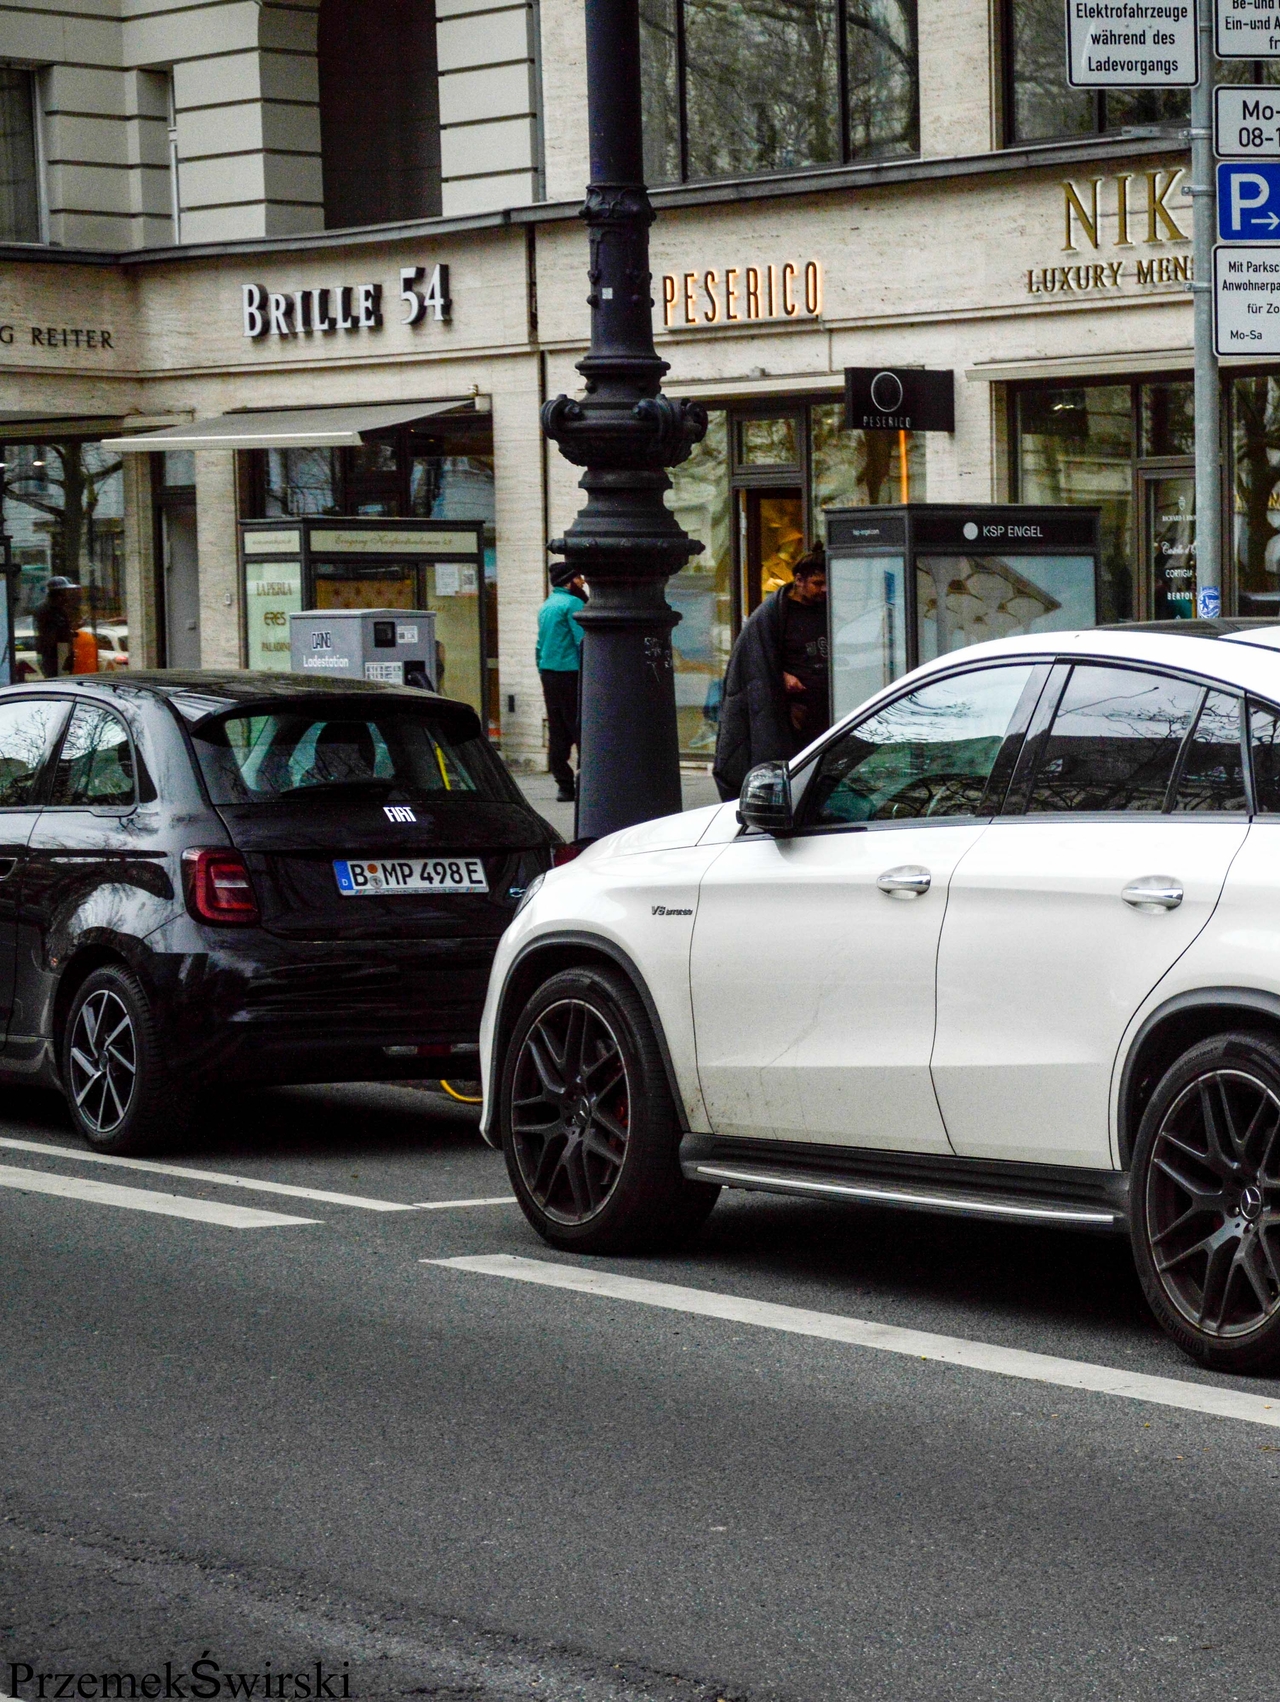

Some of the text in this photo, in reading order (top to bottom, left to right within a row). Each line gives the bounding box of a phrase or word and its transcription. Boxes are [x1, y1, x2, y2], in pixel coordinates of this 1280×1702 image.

[1076, 3, 1188, 22] Elektrofahrzeuge
[1090, 30, 1176, 45] während des
[1088, 56, 1179, 75] Ladevorgangs
[1230, 173, 1270, 231] P
[1026, 256, 1195, 294] LUXURY MEN
[1228, 261, 1245, 273] Mit
[400, 263, 452, 326] 54
[662, 260, 820, 326] PESERICO
[1247, 302, 1263, 315] für
[31, 327, 114, 349] REITER
[1230, 329, 1263, 341] Mo-Sa
[863, 416, 912, 428] PESERICO
[983, 525, 1044, 538] KSP ENGEL
[264, 611, 286, 626] ERES
[302, 654, 349, 667] Ladestation
[382, 806, 417, 823] FIAT
[350, 863, 369, 887] B
[380, 862, 414, 886] MP
